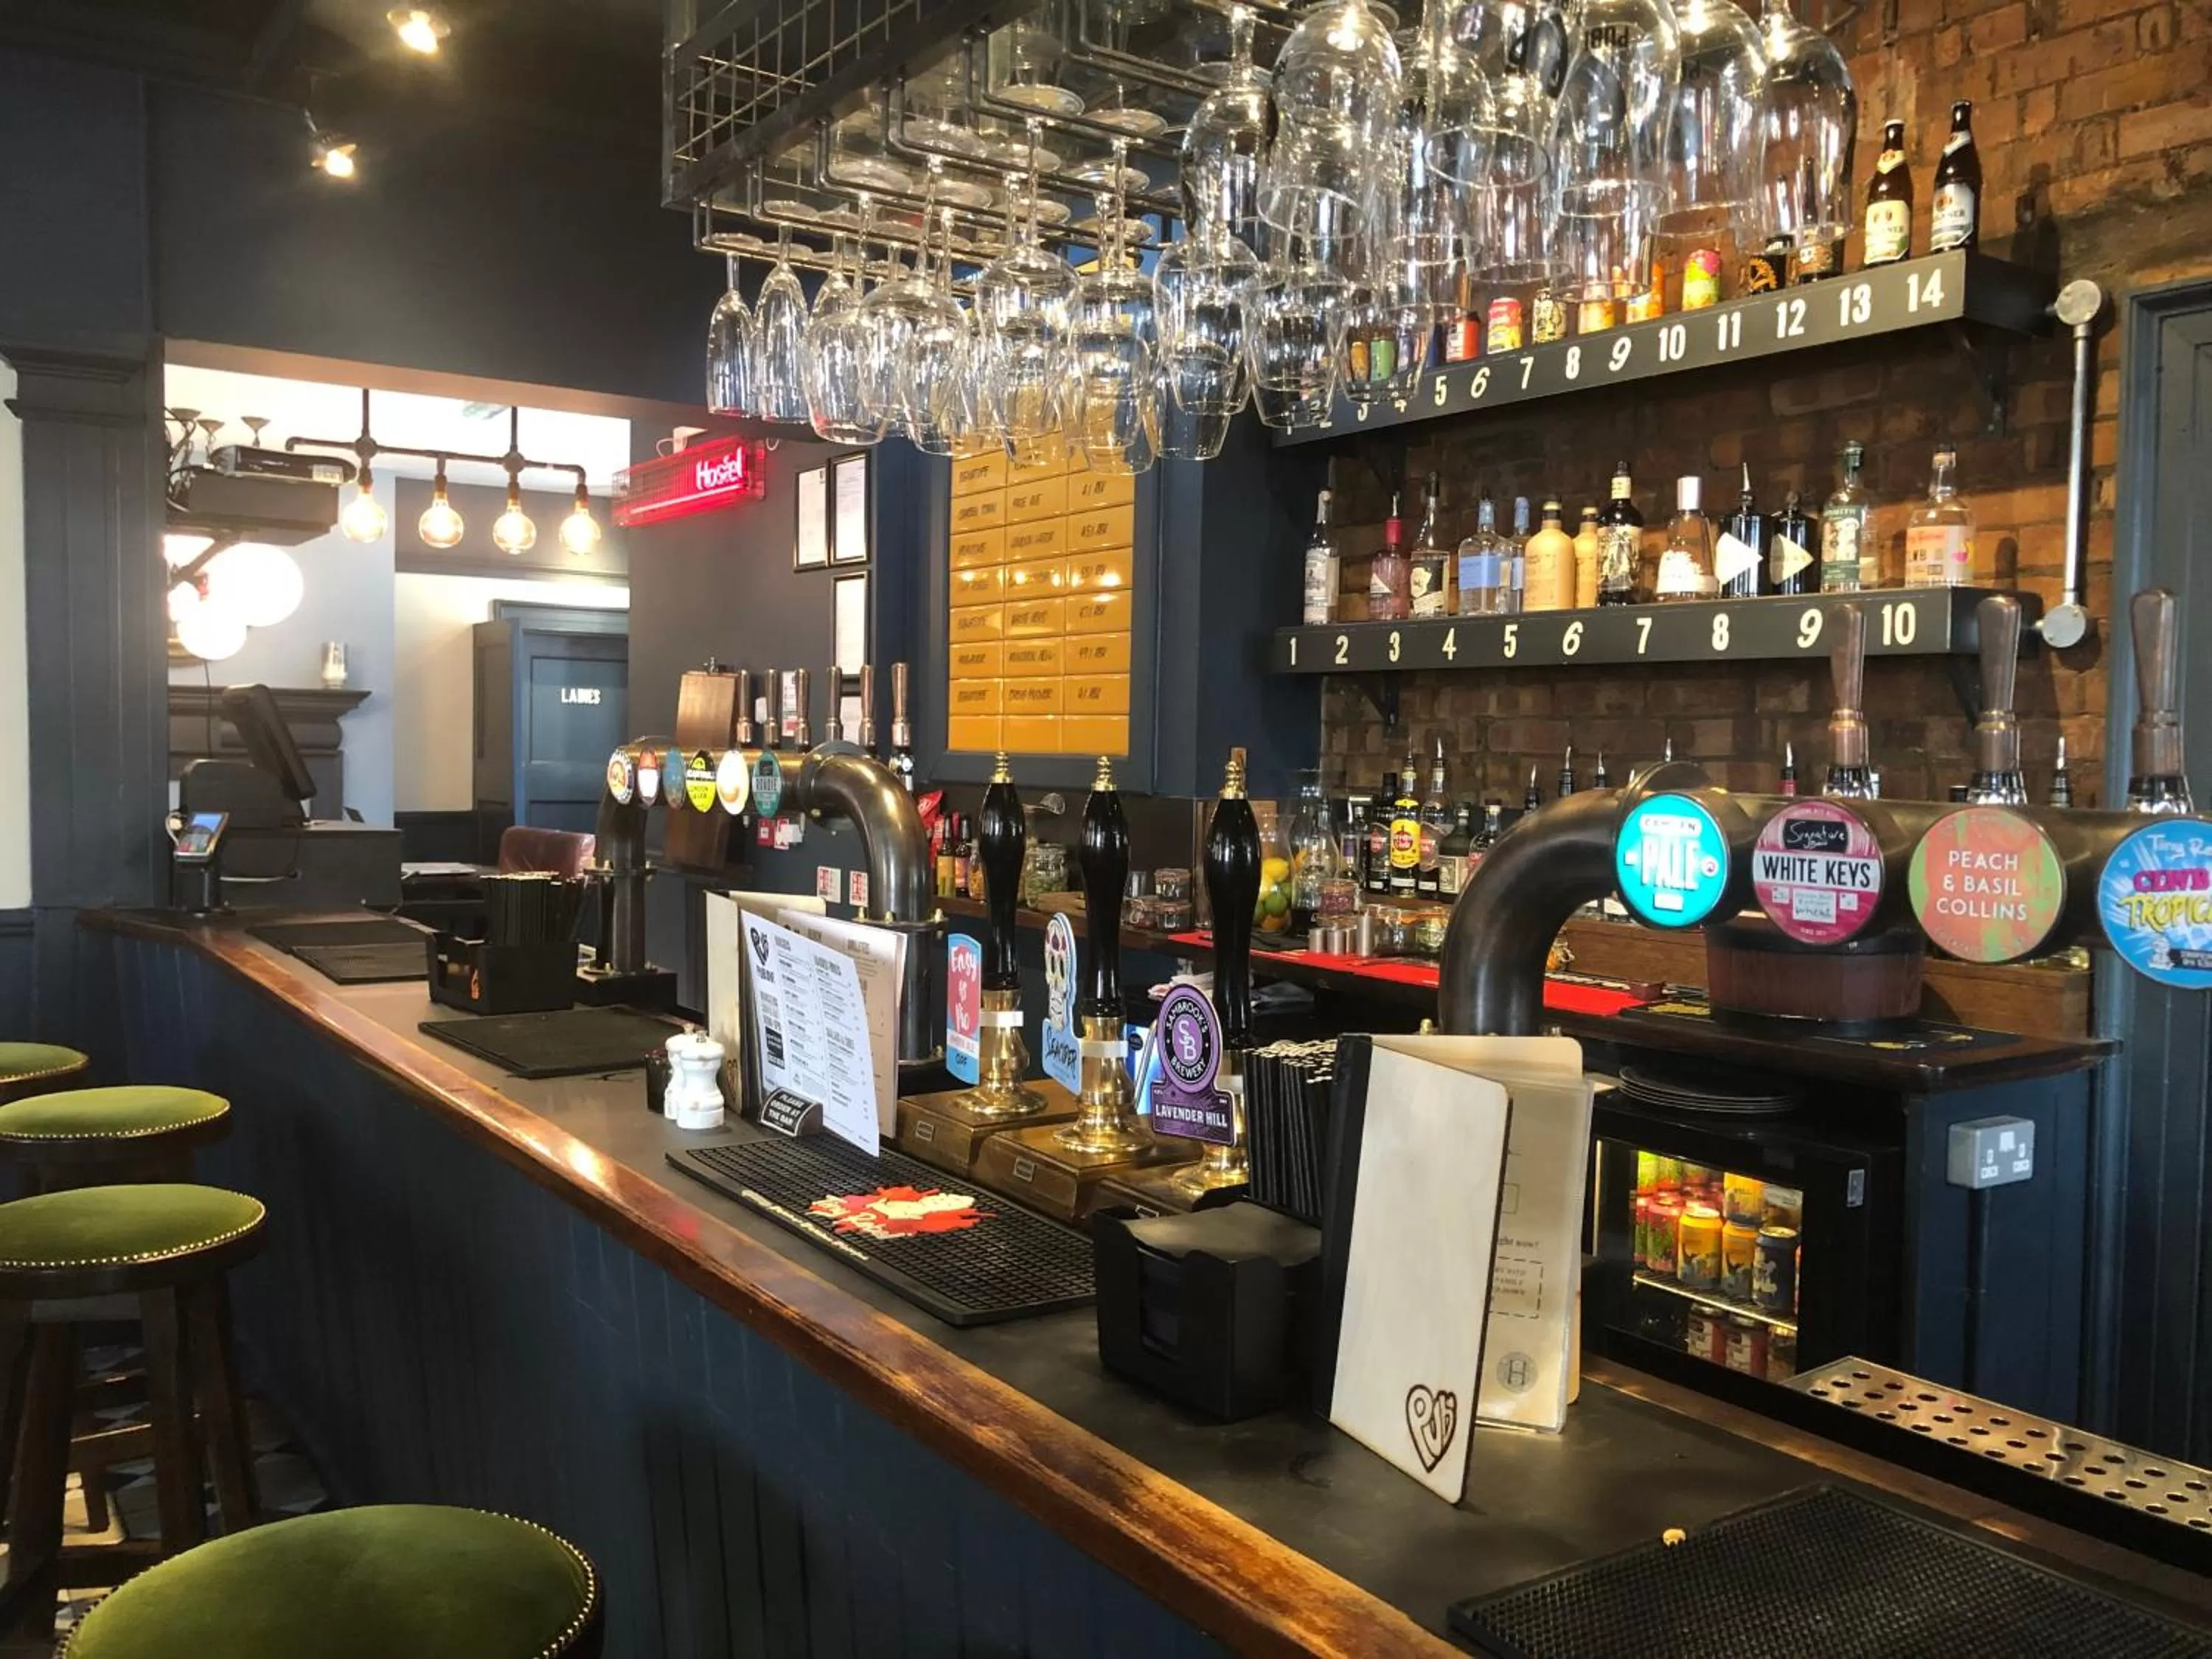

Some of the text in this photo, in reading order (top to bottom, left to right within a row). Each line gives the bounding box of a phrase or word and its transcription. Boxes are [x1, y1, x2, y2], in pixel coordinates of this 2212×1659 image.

[1433, 375, 1447, 406] 5
[1470, 366, 1490, 398] 6
[1520, 356, 1534, 389] 7
[1565, 346, 1581, 379] 8
[1608, 336, 1632, 372] 9
[1658, 324, 1686, 361] 10
[1717, 311, 1741, 350] 11
[1776, 298, 1806, 338] 12
[1840, 284, 1871, 327] 13
[1907, 268, 1944, 313] 14
[1290, 602, 1916, 665] 1 2 3 4 5 6 7 8 9 10
[1640, 835, 1700, 891] PALE
[1761, 855, 1871, 888] WHITE KEYS
[1948, 850, 2018, 871] PEACH
[1943, 874, 2022, 897] & BASIL
[1936, 897, 2027, 921] COLLINS
[1165, 1001, 1208, 1033] SAMBROOK'S
[1170, 1055, 1207, 1079] BREWERY
[768, 1108, 780, 1120] THE
[1155, 1104, 1228, 1127] LAVENDER HILL
